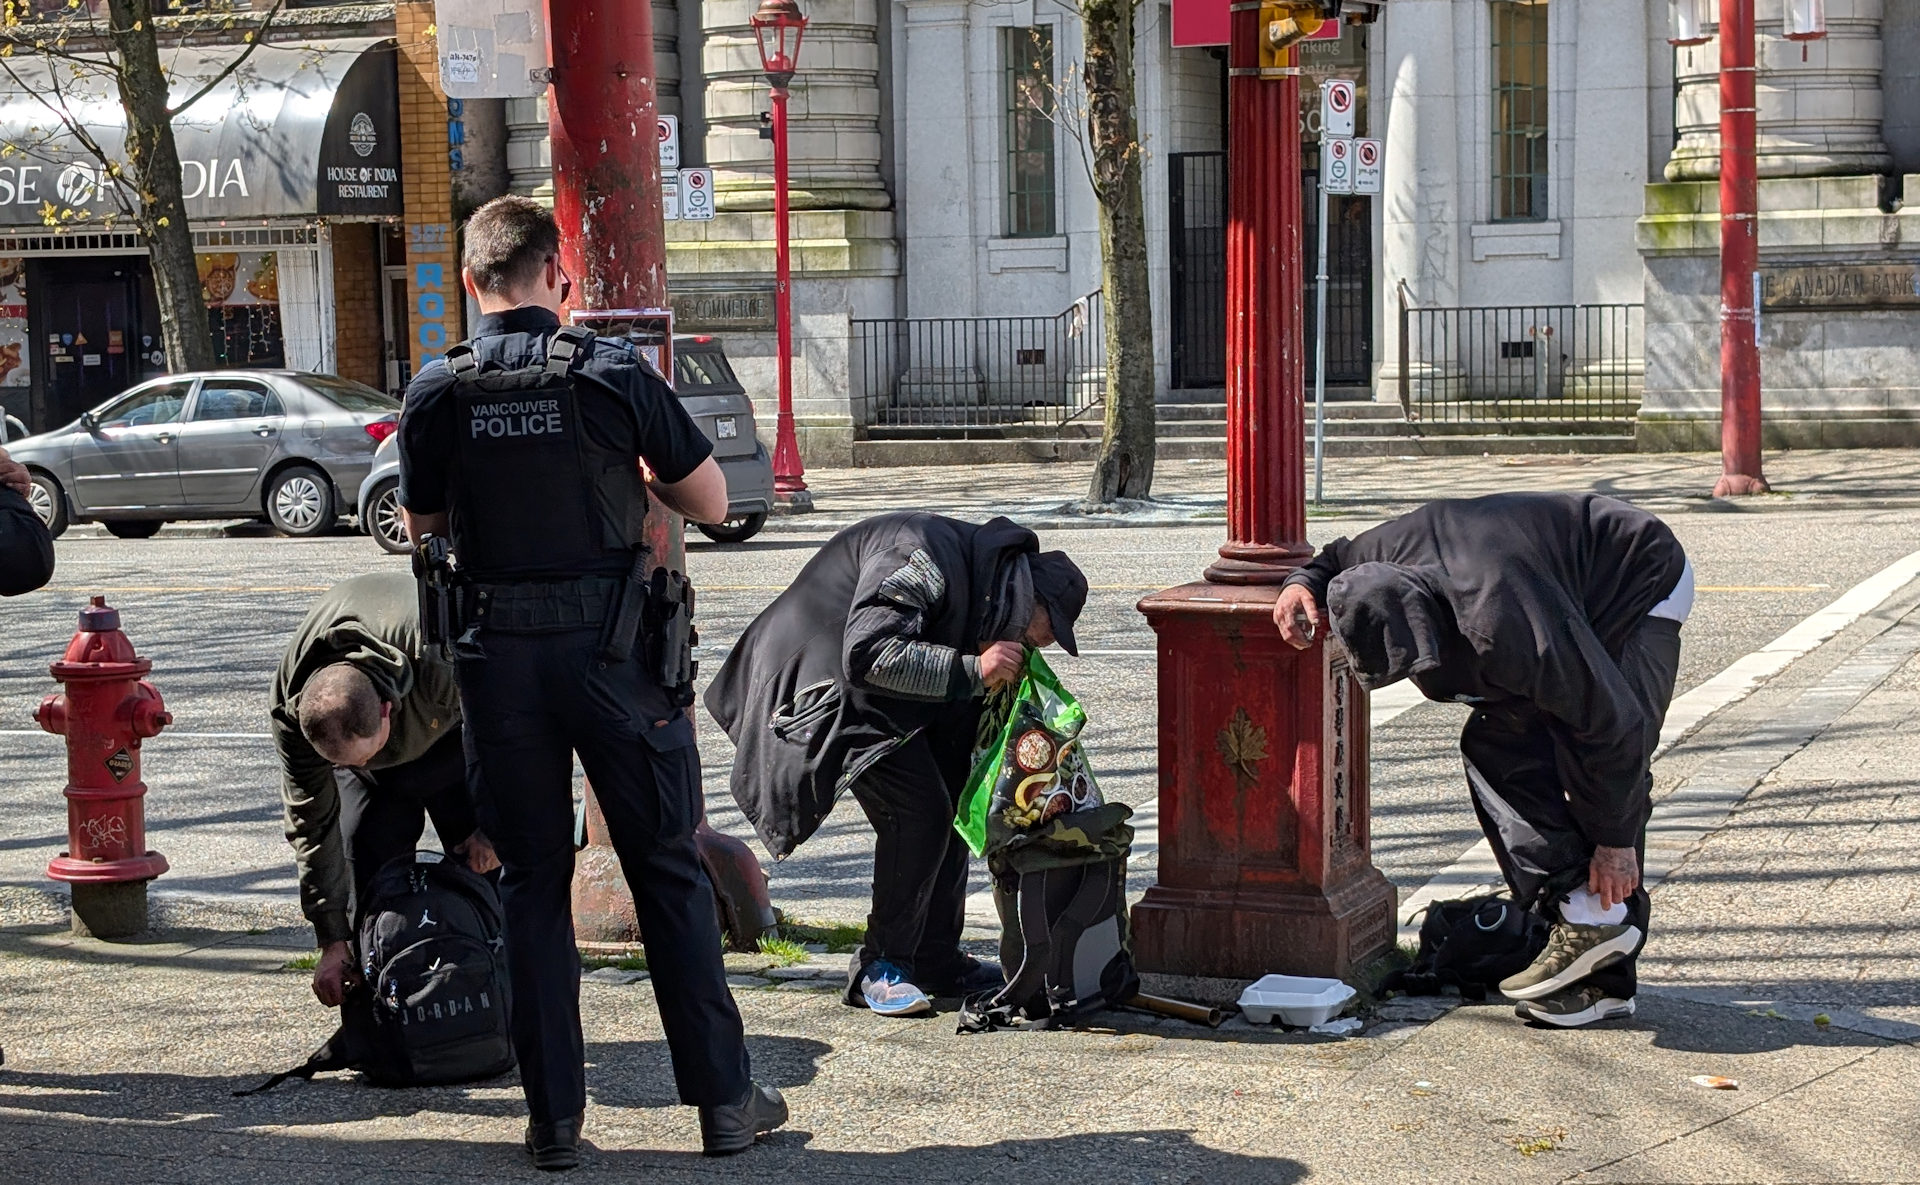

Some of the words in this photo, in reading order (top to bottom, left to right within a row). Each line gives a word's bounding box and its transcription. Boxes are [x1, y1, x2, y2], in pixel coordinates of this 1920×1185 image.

[327, 166, 358, 181] HOUSE
[359, 167, 373, 183] OF
[374, 168, 397, 182] INDIA
[338, 185, 389, 198] RESTAURENT
[1782, 274, 1864, 298] CANADIAN
[1872, 272, 1916, 297] BANK
[695, 297, 766, 320] COMMERCE
[470, 399, 560, 417] VANCOUVER
[470, 413, 563, 439] POLICE
[401, 991, 492, 1026] JORDAN
